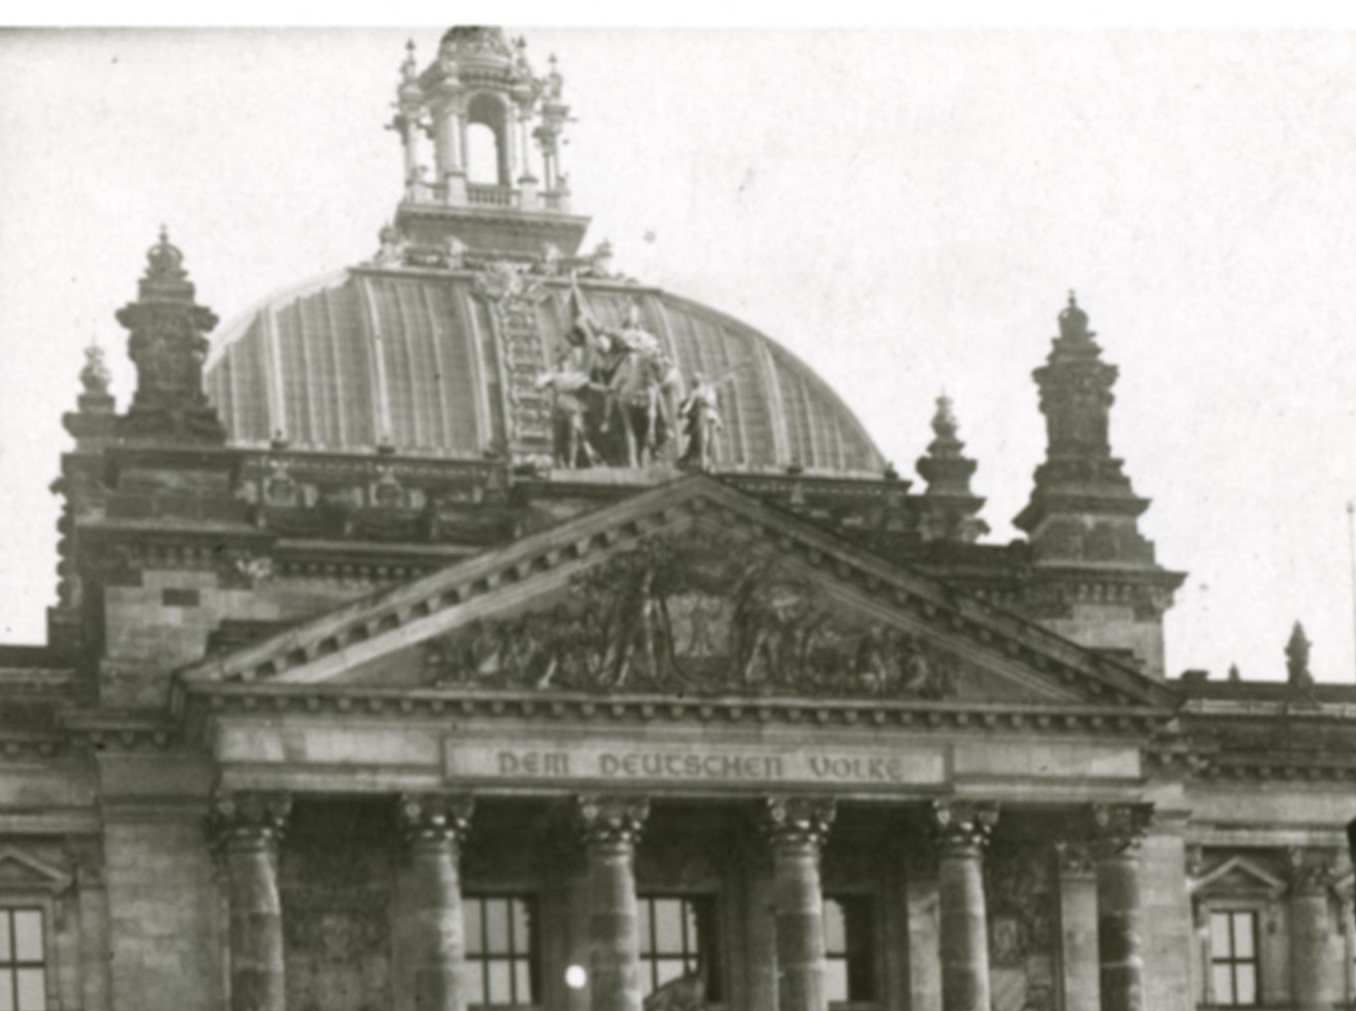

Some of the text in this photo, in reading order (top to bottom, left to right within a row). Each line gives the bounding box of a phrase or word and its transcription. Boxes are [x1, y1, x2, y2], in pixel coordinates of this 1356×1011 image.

[497, 751, 903, 779] DEM DEUTSCHEN VOLKE
